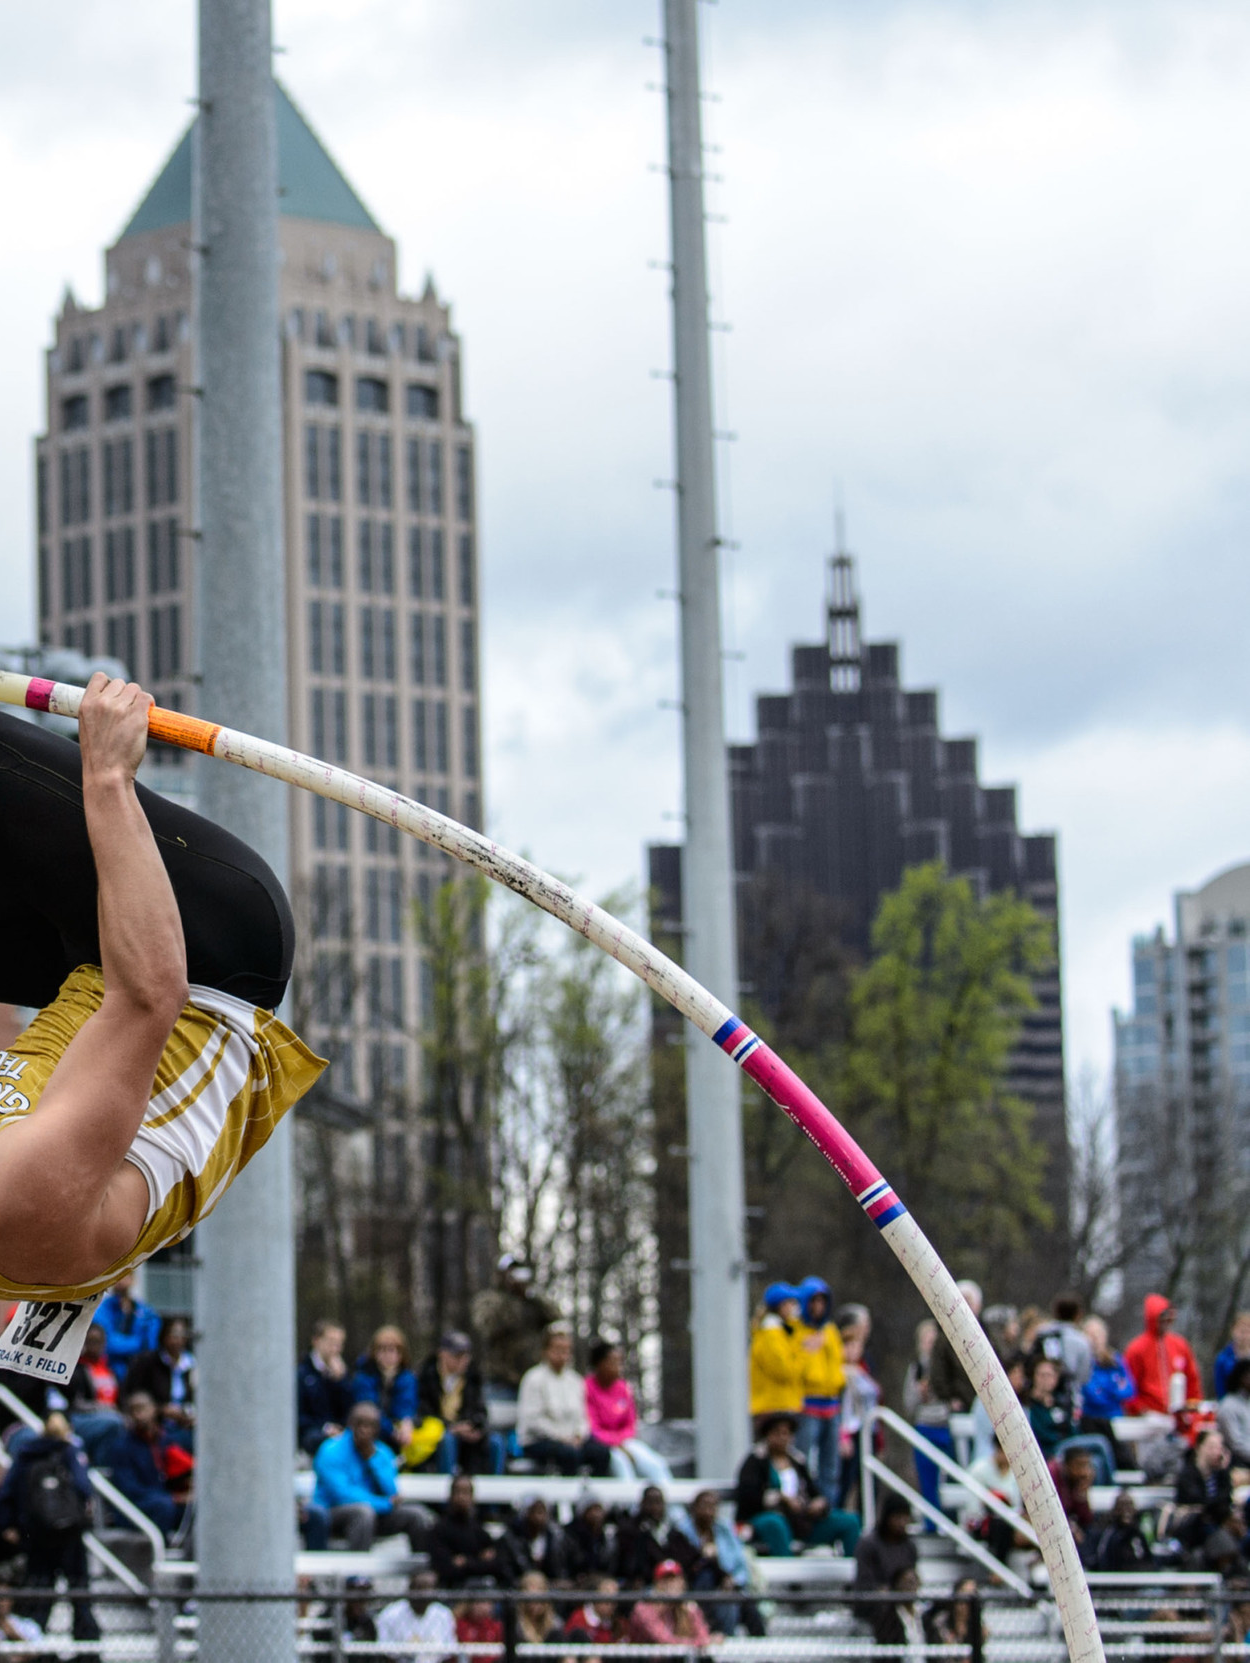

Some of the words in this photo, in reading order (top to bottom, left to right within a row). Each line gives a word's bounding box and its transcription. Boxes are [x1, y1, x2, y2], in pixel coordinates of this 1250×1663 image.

[11, 1300, 84, 1352] 327
[25, 1355, 32, 1366] &
[35, 1357, 67, 1375] FIELD
